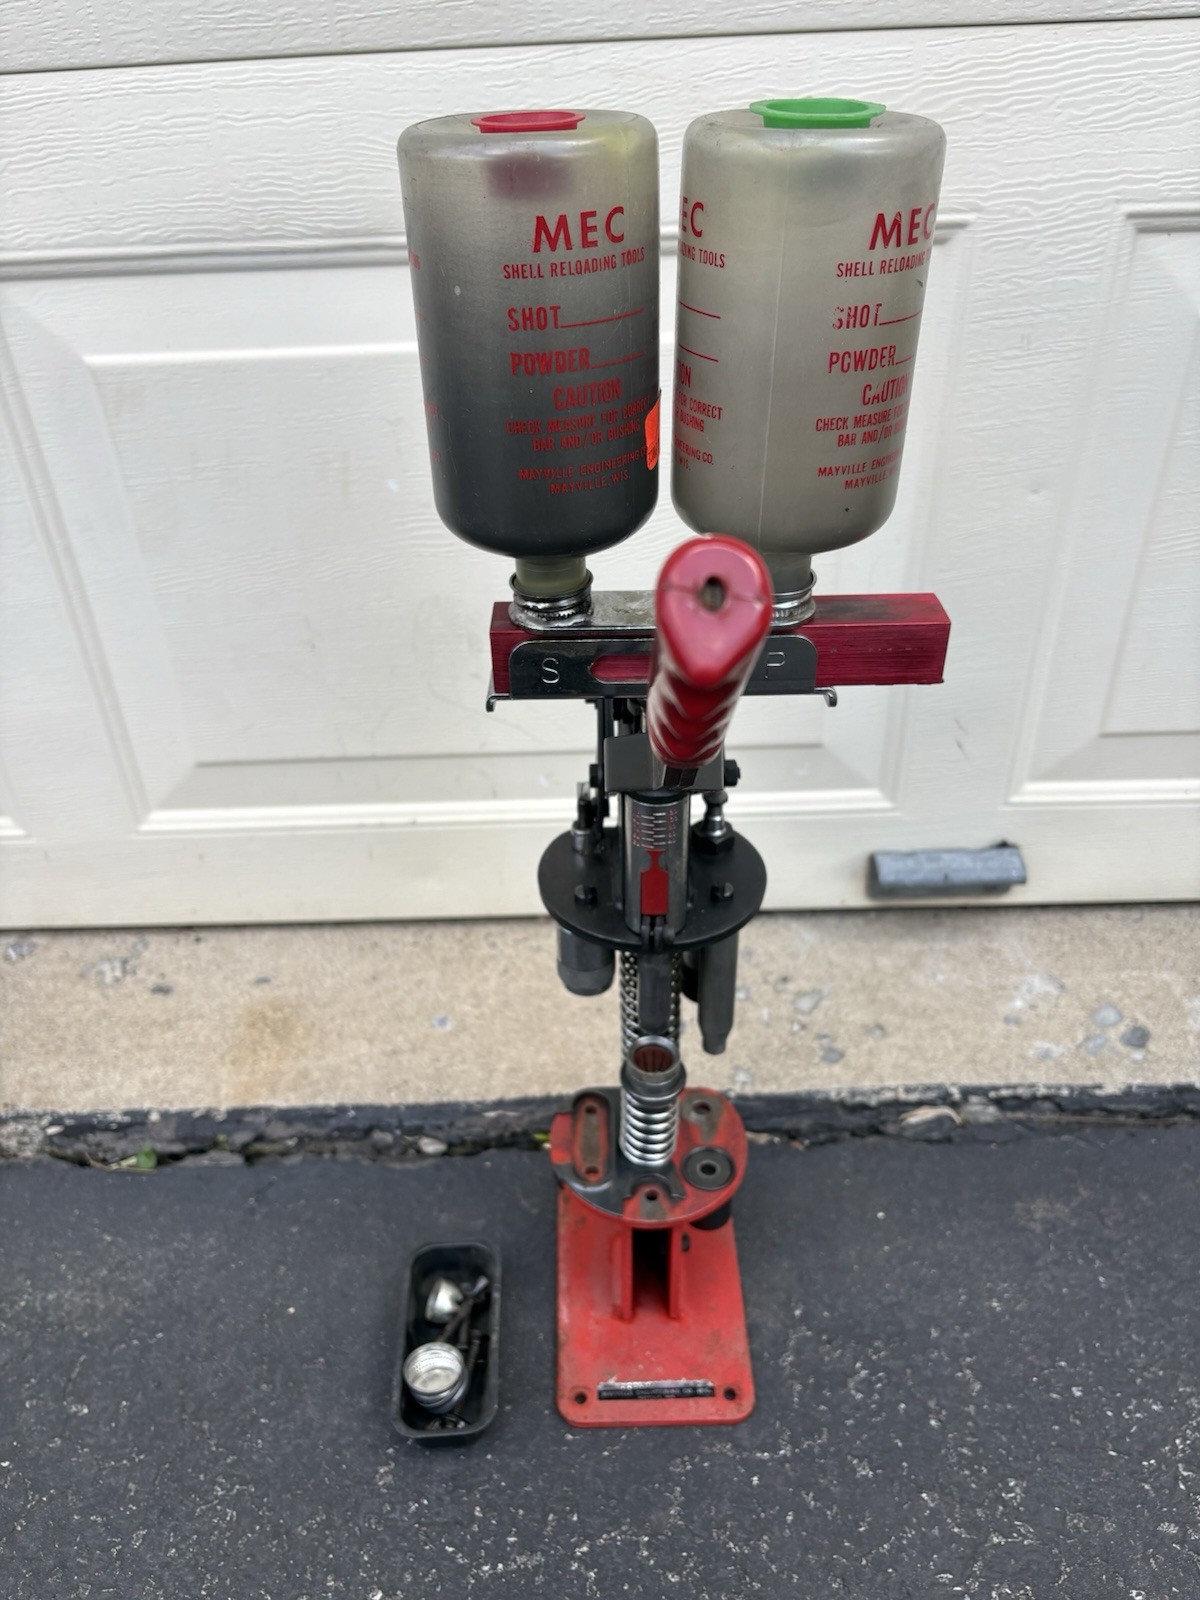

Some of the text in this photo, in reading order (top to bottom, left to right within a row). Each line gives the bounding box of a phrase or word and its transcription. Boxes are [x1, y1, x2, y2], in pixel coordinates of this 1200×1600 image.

[533, 206, 625, 253] MEC
[681, 196, 704, 238] EC
[869, 202, 935, 251] MEC
[503, 247, 646, 280] SHELL RELOADING TOOLS
[699, 248, 725, 269] TOOLS
[836, 261, 875, 278] SHELL
[879, 251, 925, 275] RELOADING
[507, 305, 561, 331] SHOT
[832, 303, 883, 330] SHOT
[510, 347, 591, 377] POWDER
[828, 345, 897, 374] POWDER
[553, 377, 623, 411] CAUTION
[862, 372, 909, 406] CAUTION
[504, 418, 542, 435] CHECK
[547, 413, 597, 434] MEASURE
[600, 408, 619, 426] FOR
[690, 398, 722, 420] CORRECT
[815, 416, 849, 432] CHECK
[853, 409, 892, 429] MEASURE
[532, 436, 555, 452] BAR
[837, 432, 857, 448] BAR
[518, 466, 574, 481] MAYVILLE
[579, 451, 640, 476] ENGINEERING
[818, 461, 867, 478] MAYVILLE
[551, 476, 607, 495] MAYVILLE
[844, 470, 887, 490] MAYVILLE
[541, 657, 560, 684] S
[765, 651, 786, 679] P
